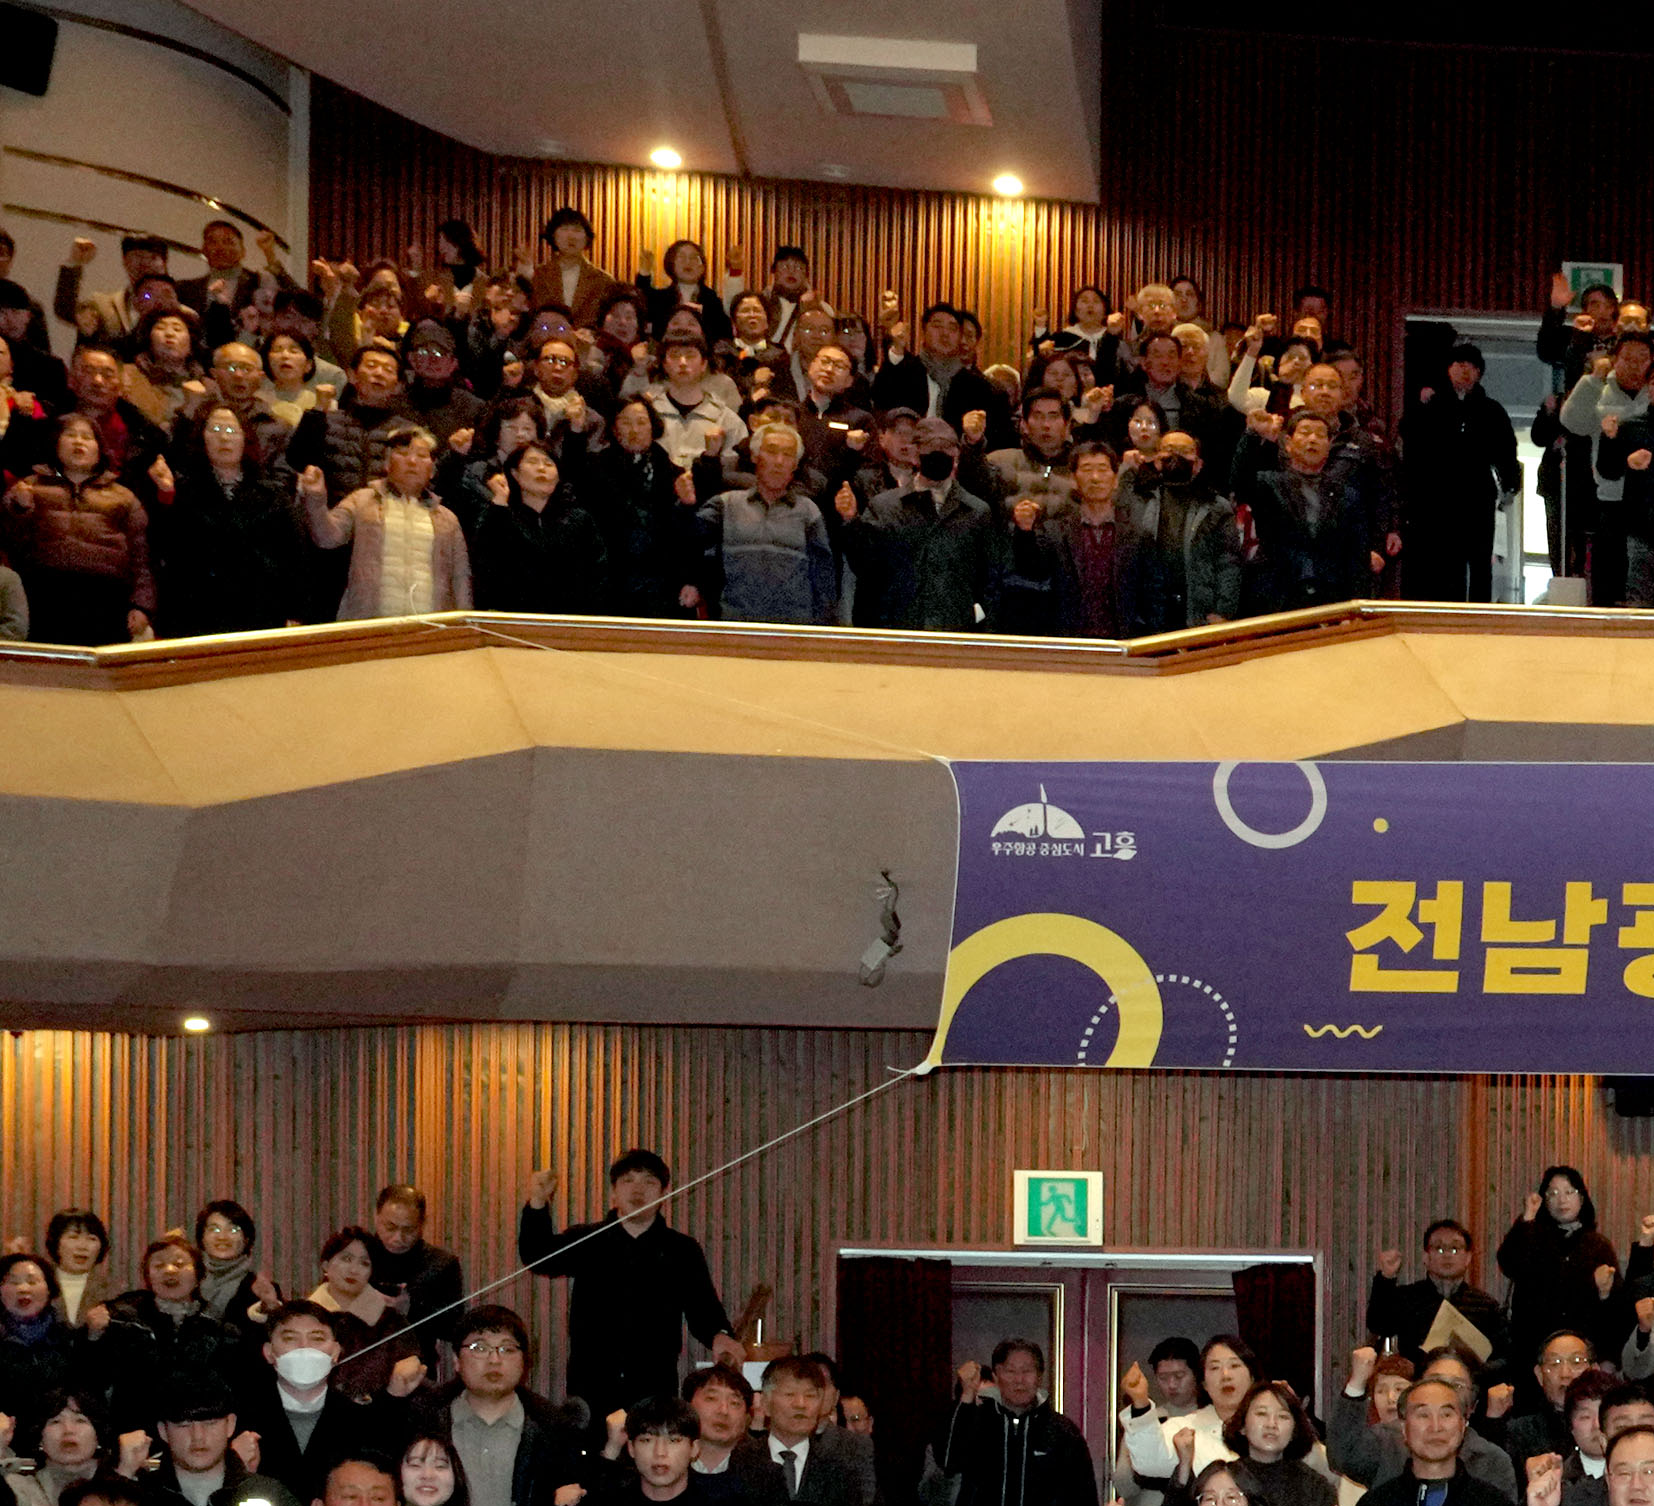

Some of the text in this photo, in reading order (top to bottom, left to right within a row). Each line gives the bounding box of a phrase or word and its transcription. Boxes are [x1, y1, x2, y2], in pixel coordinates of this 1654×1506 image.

[991, 831, 1138, 861] 우주항공 중심도시 고흥
